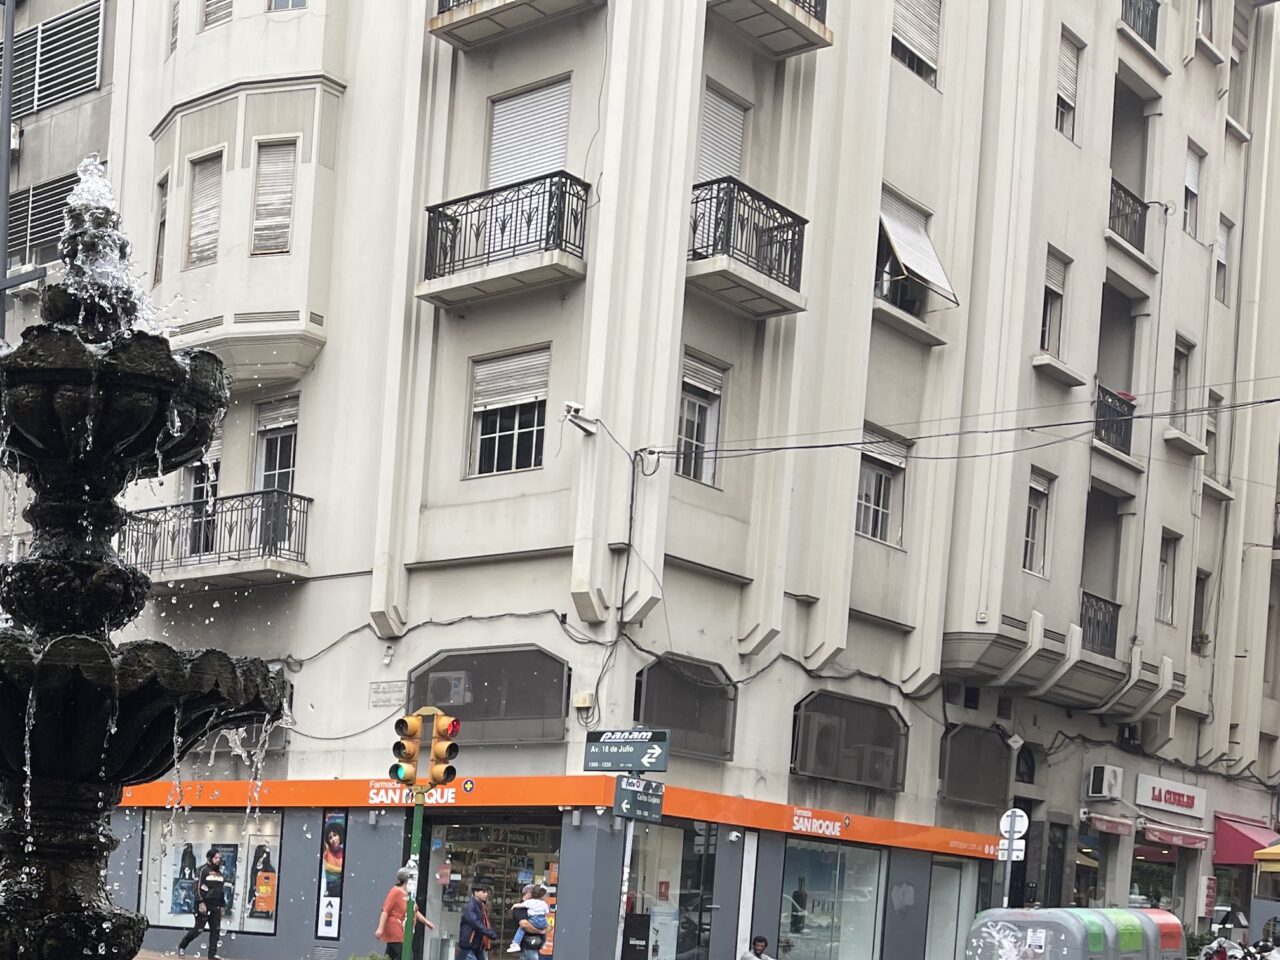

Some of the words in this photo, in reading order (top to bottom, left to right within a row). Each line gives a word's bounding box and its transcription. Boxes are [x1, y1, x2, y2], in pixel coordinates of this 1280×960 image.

[600, 731, 652, 742] panam
[590, 745, 601, 753] Av.
[610, 745, 618, 753] de
[619, 744, 634, 753] Julio
[369, 788, 399, 804] SAN
[793, 816, 811, 833] SAN
[811, 819, 842, 836] ROQUE
